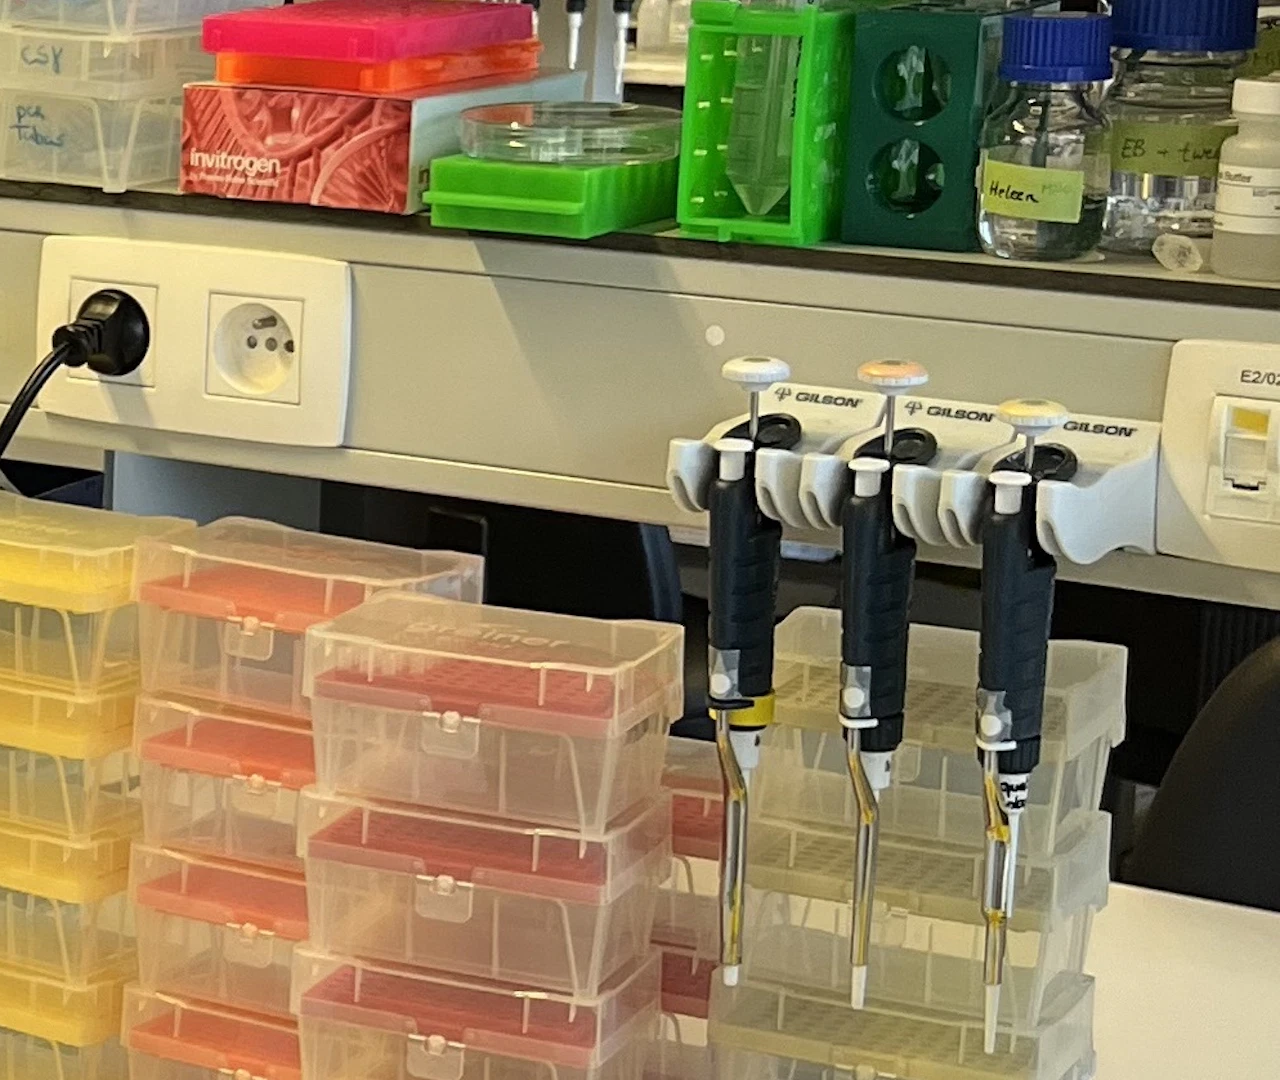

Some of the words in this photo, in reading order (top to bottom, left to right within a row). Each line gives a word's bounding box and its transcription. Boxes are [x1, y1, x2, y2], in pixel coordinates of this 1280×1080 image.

[21, 45, 62, 74] CSY
[1121, 138, 1146, 159] EB
[189, 147, 280, 177] invitrogen
[989, 180, 1040, 203] Heleen
[795, 391, 860, 408] GILSON
[926, 405, 995, 422] GILSON
[1063, 420, 1135, 437] GILSON
